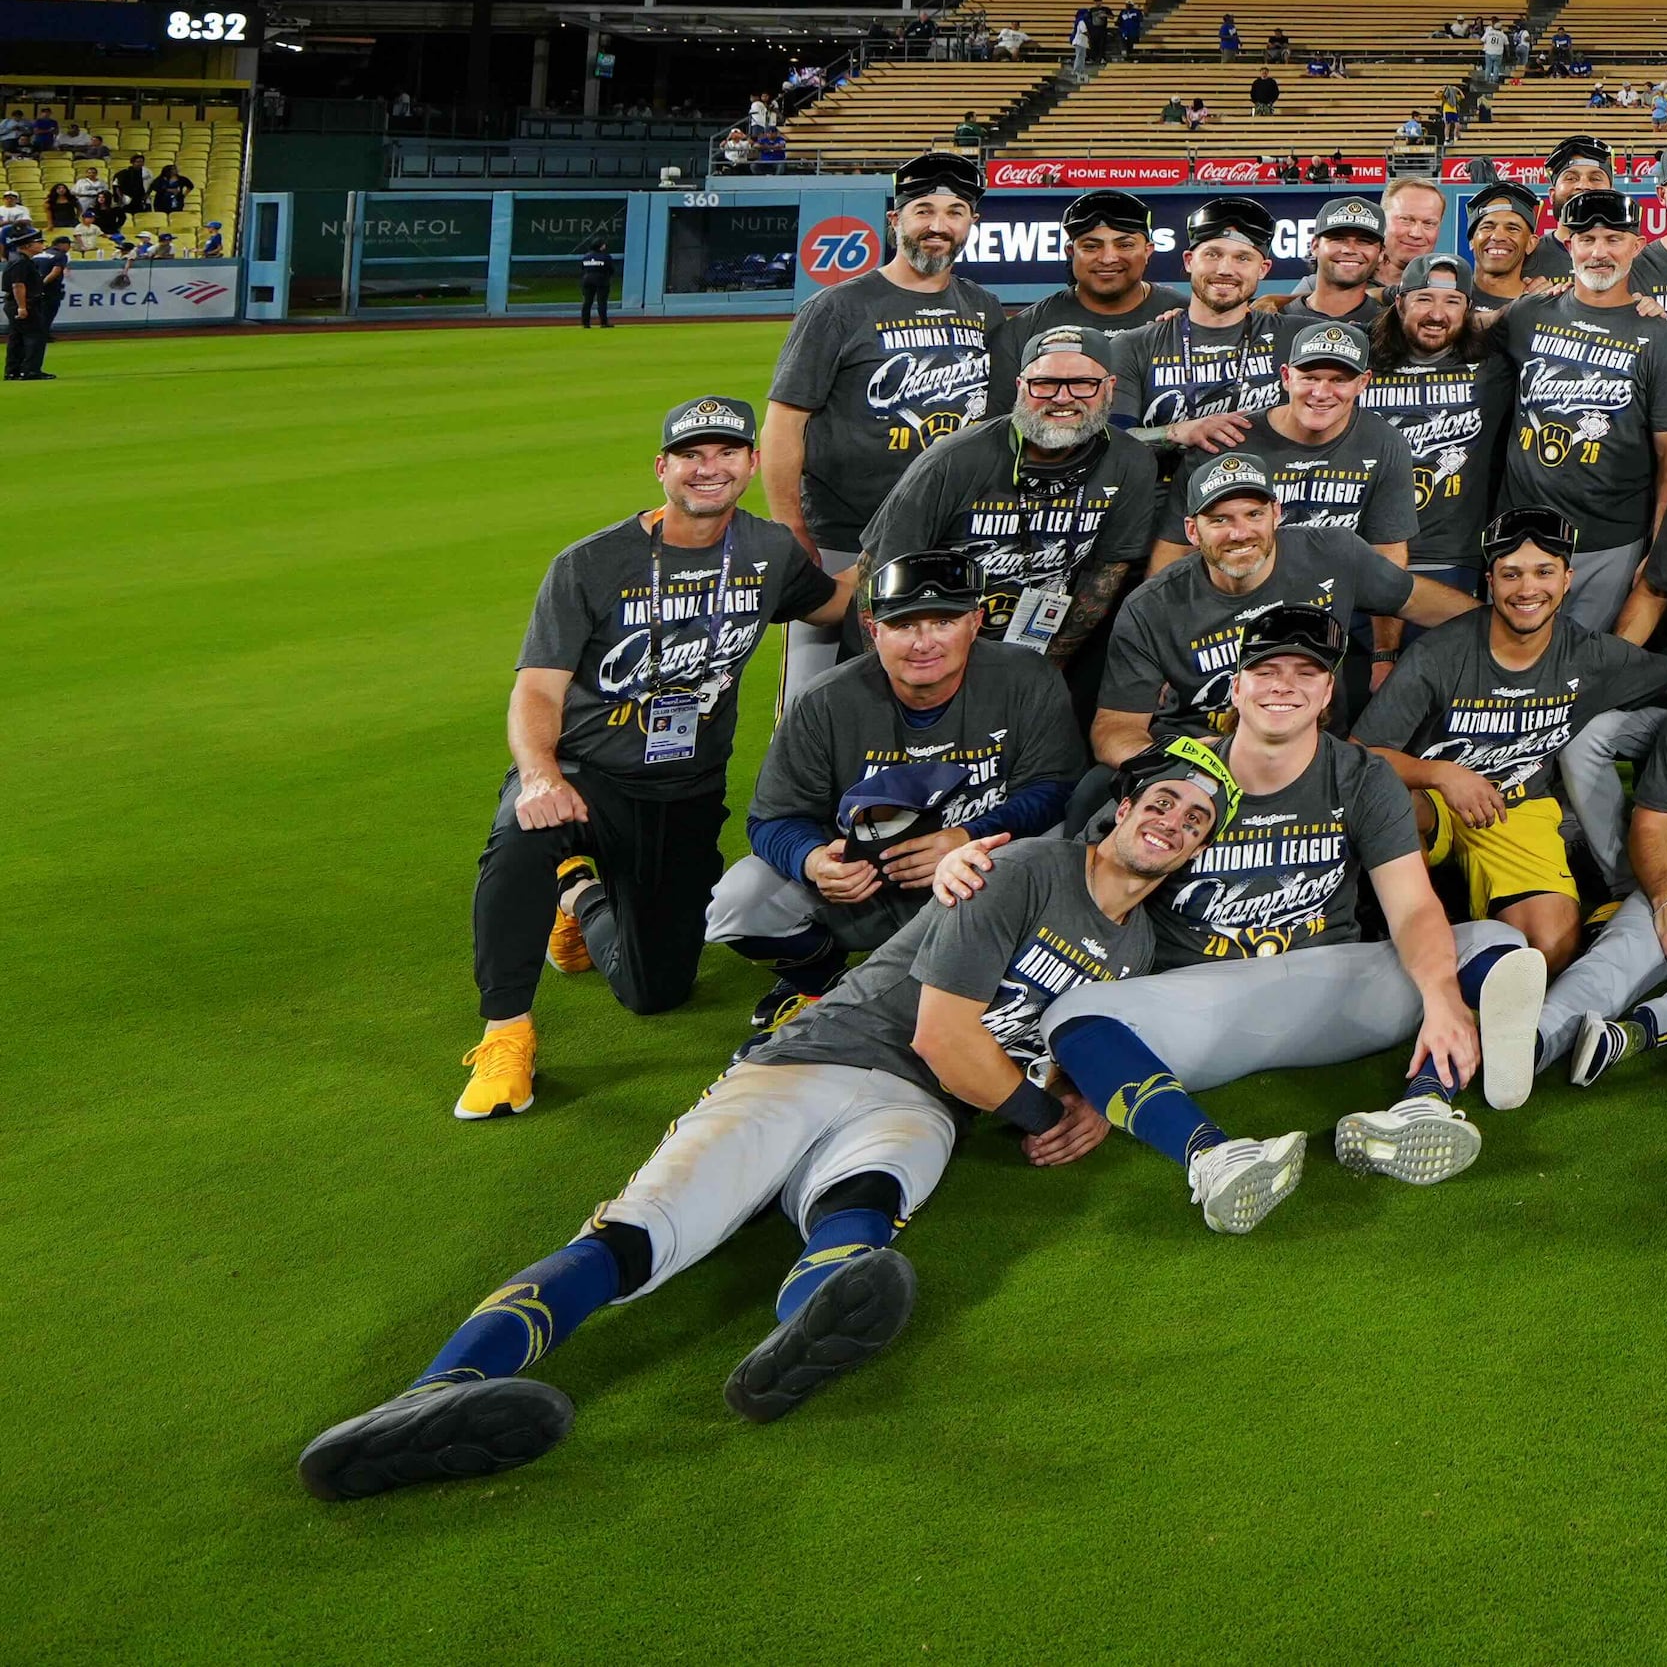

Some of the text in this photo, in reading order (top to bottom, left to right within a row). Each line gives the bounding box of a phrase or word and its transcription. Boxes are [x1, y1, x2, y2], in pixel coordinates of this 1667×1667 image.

[167, 11, 247, 41] 8:32
[1068, 169, 1106, 179] HOME
[1109, 169, 1137, 179] RUN
[1141, 169, 1180, 179] MAGIC
[683, 193, 720, 207] 360
[811, 230, 870, 272] 76
[1530, 334, 1637, 372] NATIONAL LEAGUE
[1519, 357, 1634, 413] Champions
[670, 413, 745, 435] WORLD SERIES
[1581, 441, 1600, 464] 26
